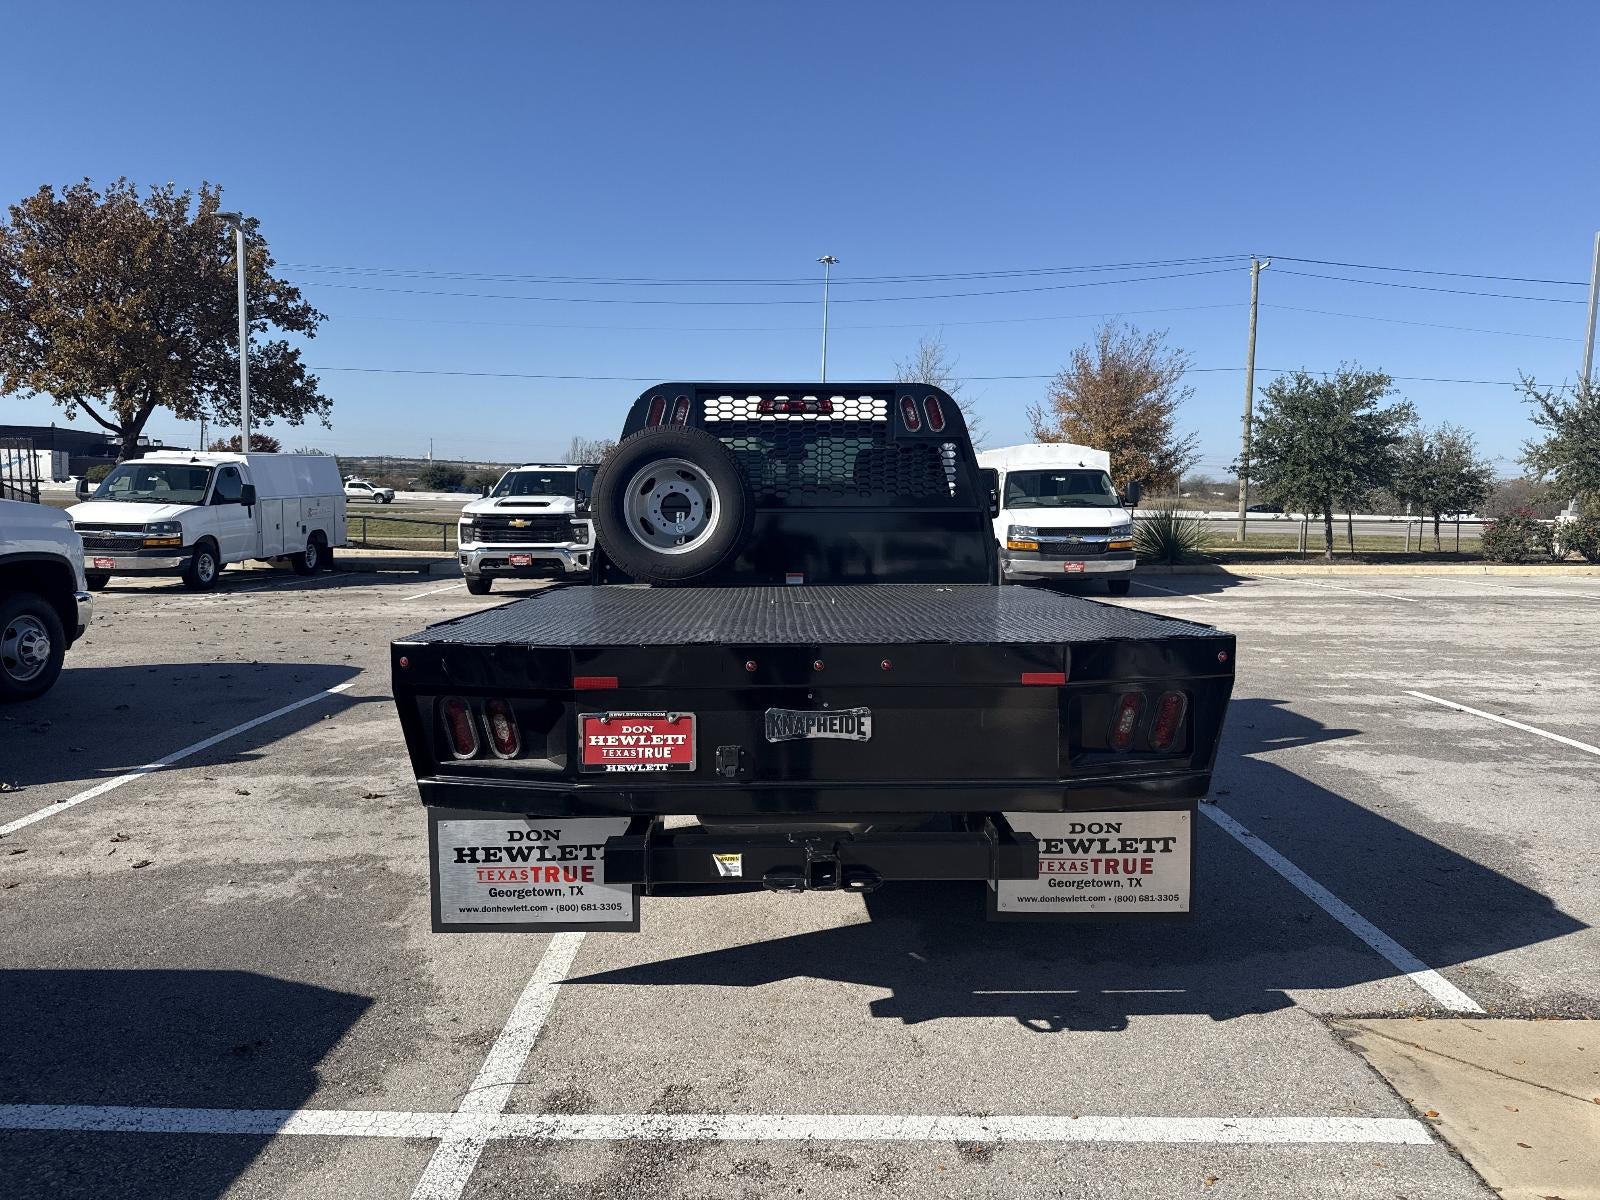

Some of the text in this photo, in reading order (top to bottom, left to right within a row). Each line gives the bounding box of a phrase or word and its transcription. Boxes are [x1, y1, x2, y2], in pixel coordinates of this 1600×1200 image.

[621, 725, 655, 734] DON
[768, 712, 867, 736] KNAPHEIDE
[588, 735, 687, 746] HEWLETT
[605, 763, 669, 772] HEWLETT
[1068, 822, 1123, 835] DON
[507, 829, 562, 842] DON
[1048, 877, 1143, 890] Georgetown, TX
[488, 885, 585, 899] Georgetown, TX
[1017, 893, 1180, 904] www.donhewlett.com (800) 681-3305
[458, 902, 622, 913] www.donhewlett.com (800) 681-3305
